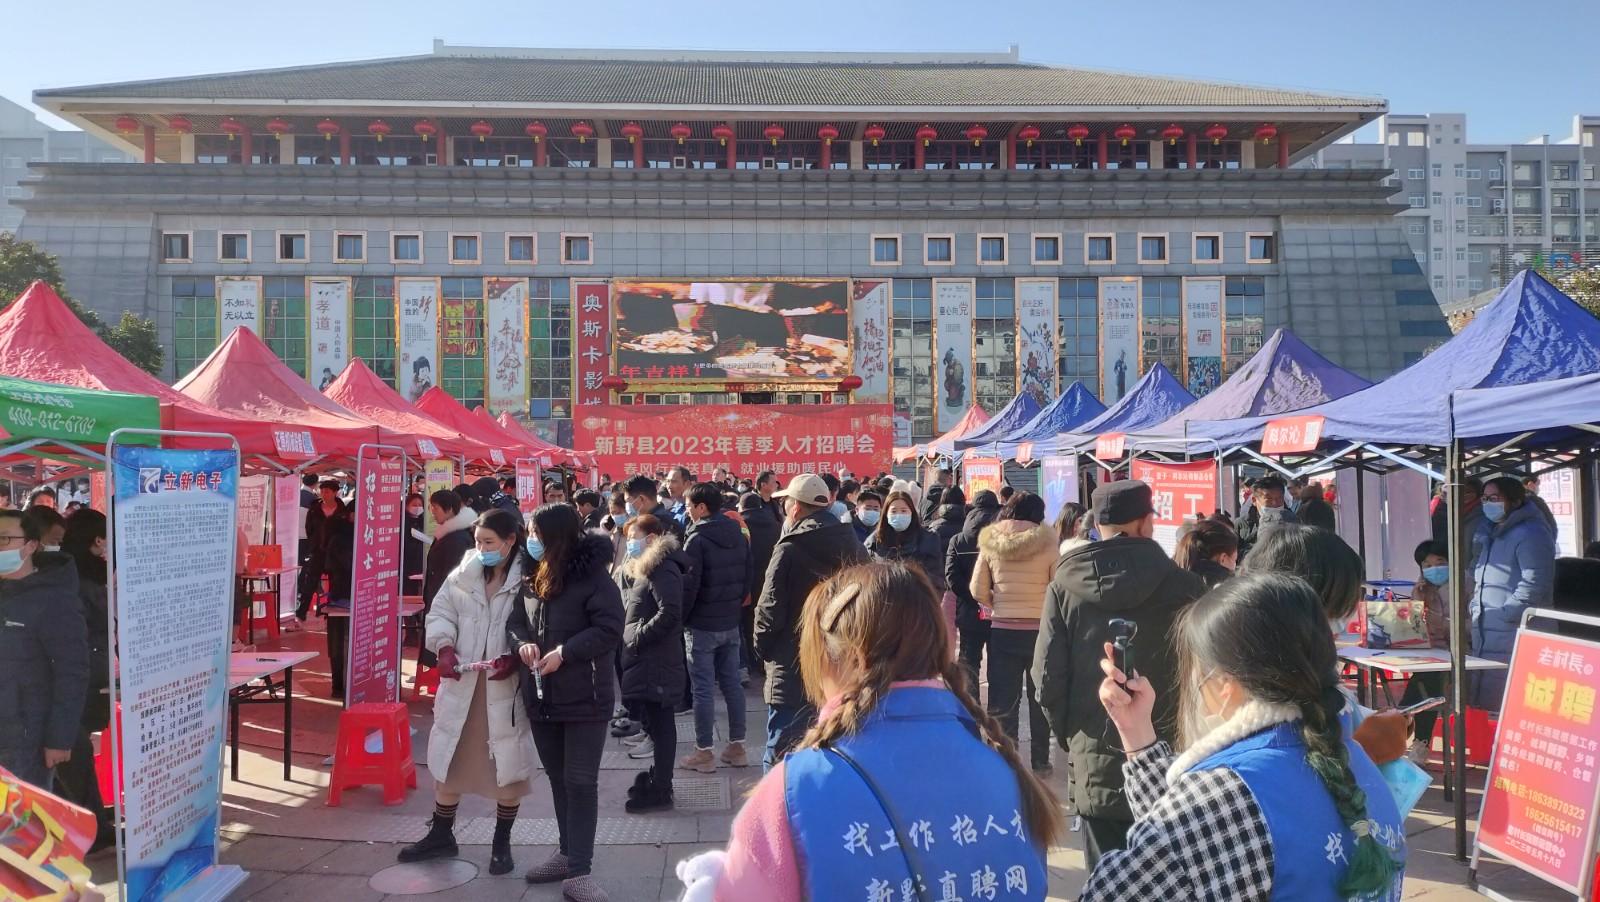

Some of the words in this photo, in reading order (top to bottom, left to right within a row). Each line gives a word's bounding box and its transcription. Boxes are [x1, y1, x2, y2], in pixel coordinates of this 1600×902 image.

[315, 300, 330, 330] 孝道
[595, 434, 875, 456] 新野县2023年春季人才招聘会
[1269, 423, 1301, 446] 科尔沁
[164, 471, 222, 491] 立新电子
[740, 461, 848, 475] 就业援助暖民心
[1152, 489, 1204, 521] 招工
[1524, 672, 1597, 726] 诚聘
[842, 819, 935, 856] 找工作
[1525, 806, 1583, 839] 18625615417
